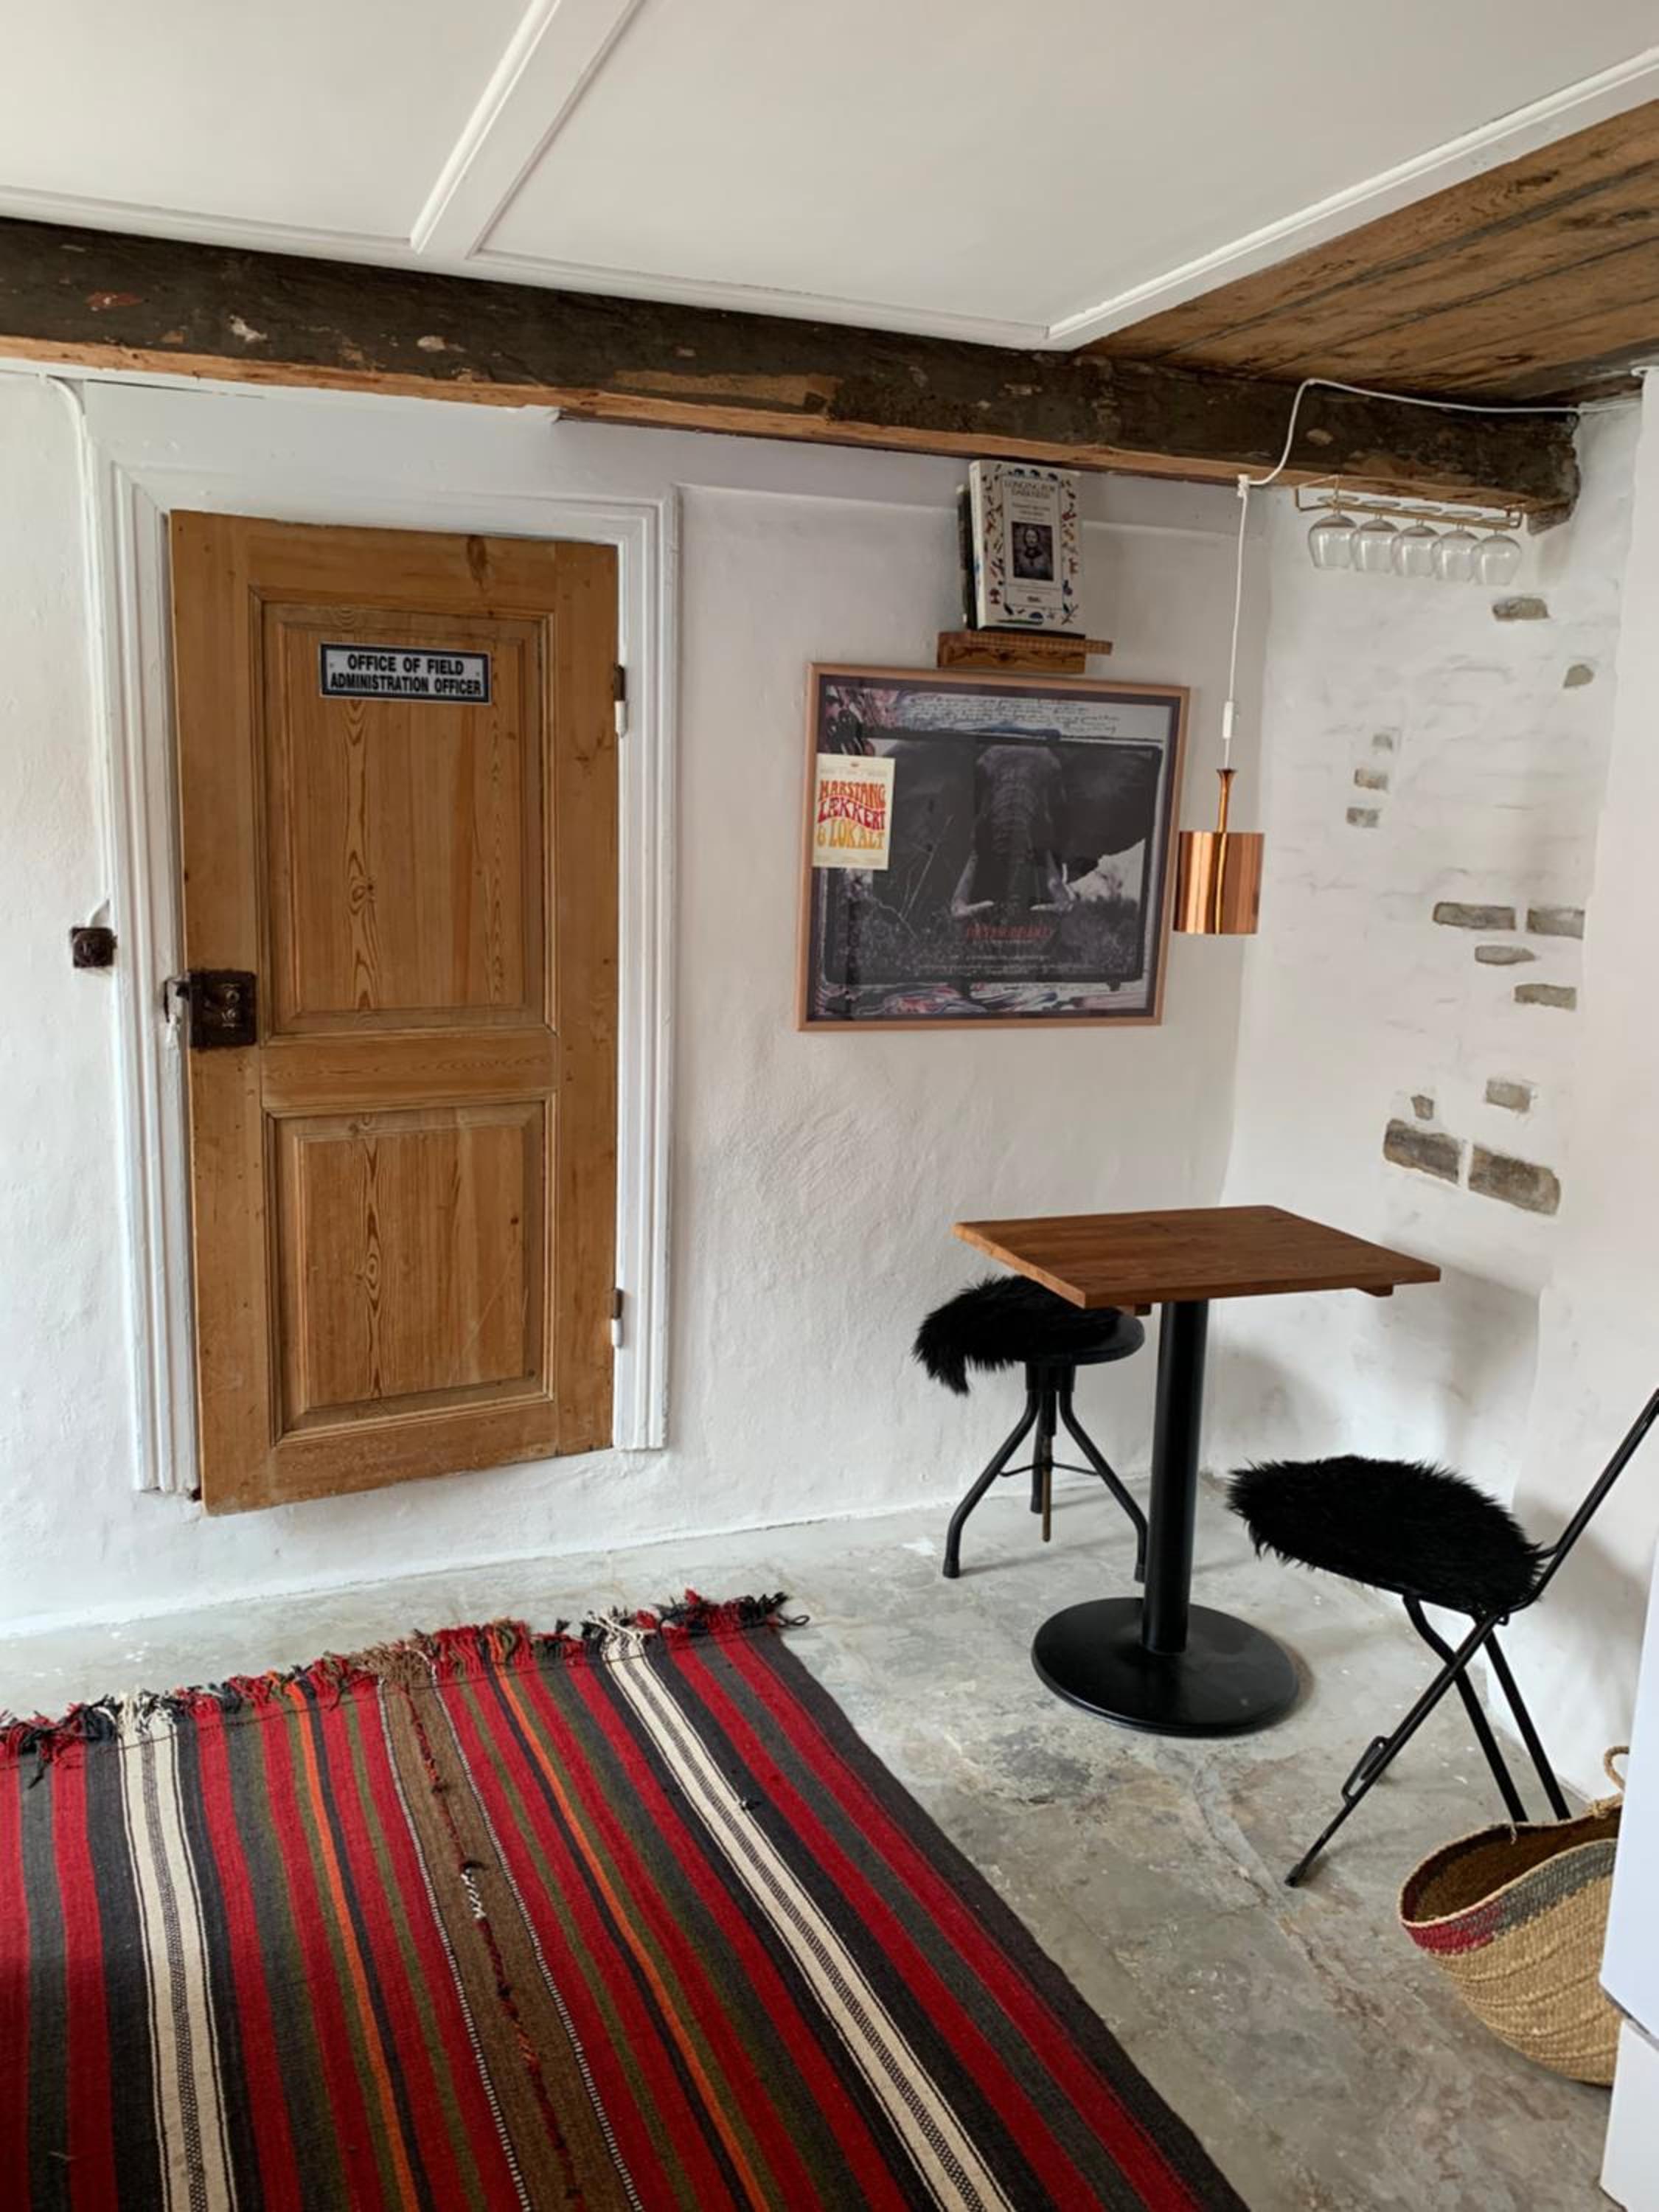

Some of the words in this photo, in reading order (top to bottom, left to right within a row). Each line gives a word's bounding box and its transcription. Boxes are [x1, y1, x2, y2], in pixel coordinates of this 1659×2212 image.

[347, 654, 397, 672] OFFICE
[403, 657, 421, 673] OF
[427, 658, 465, 675] FIELD
[330, 672, 429, 692] ADMINISTRATION
[434, 678, 481, 695] OFFICER
[818, 797, 886, 830] LÆKKERT
[829, 818, 885, 849] LOKALT
